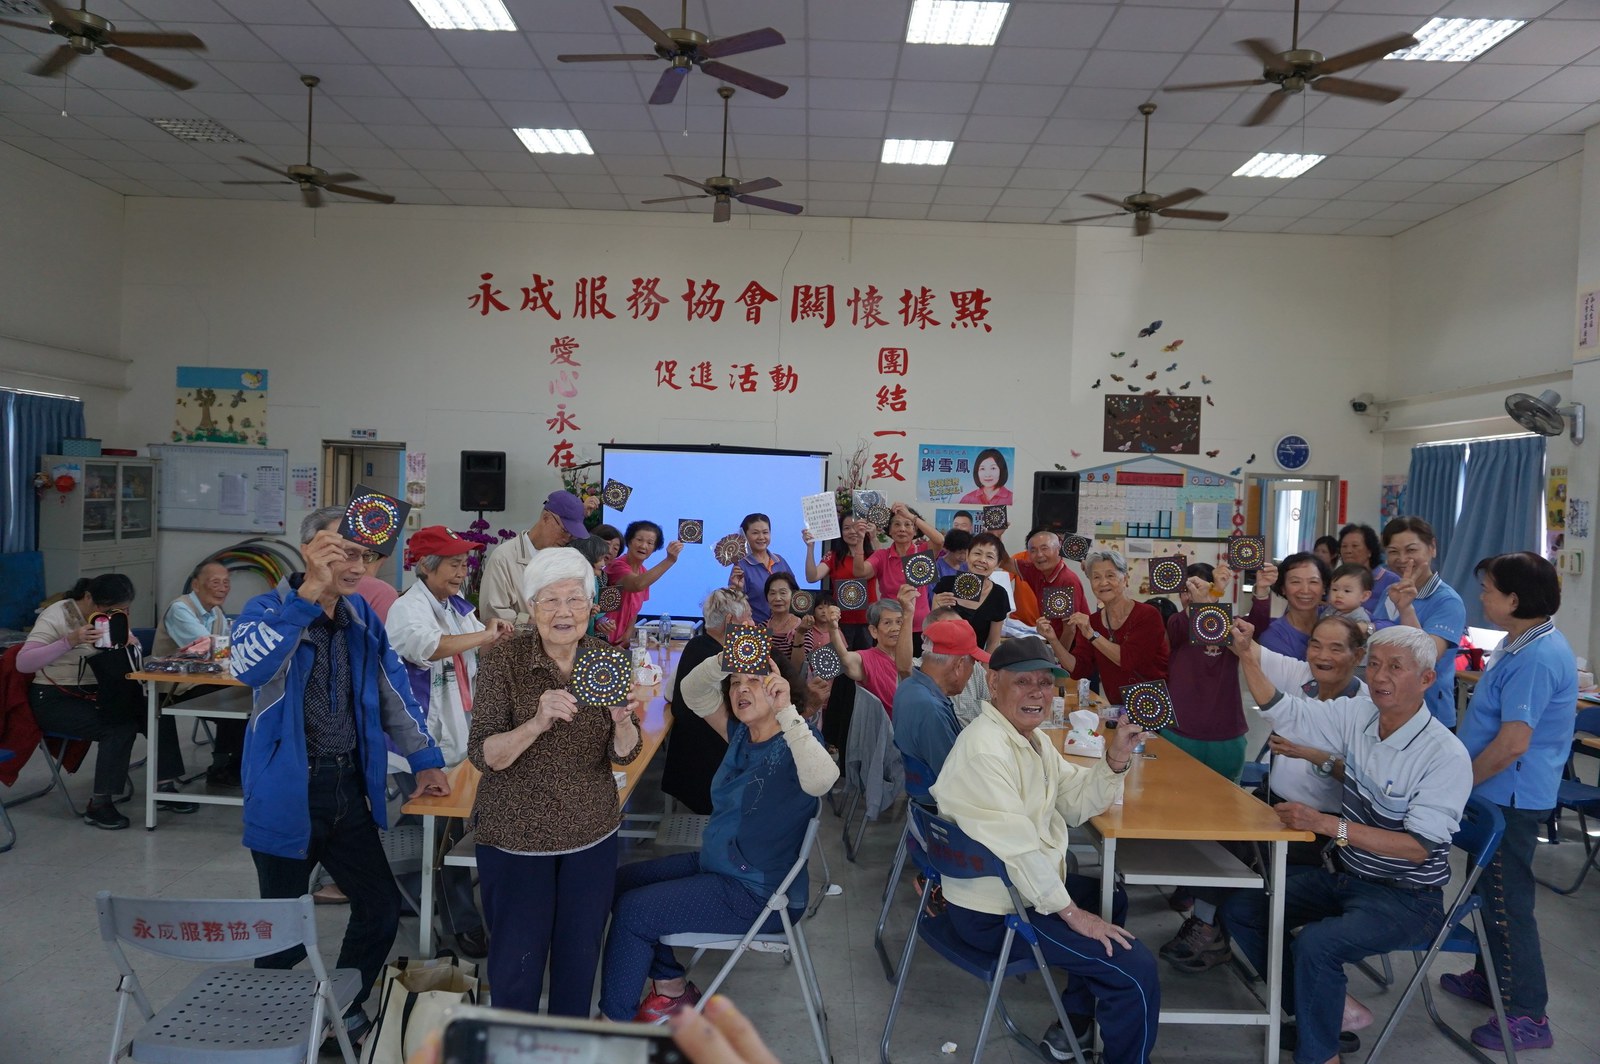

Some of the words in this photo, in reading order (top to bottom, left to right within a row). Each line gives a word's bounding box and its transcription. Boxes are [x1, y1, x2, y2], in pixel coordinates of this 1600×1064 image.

[467, 272, 993, 333] 永成服務協會關懷據點
[655, 359, 799, 394] 促進活動
[546, 336, 581, 468] 愛心永在
[871, 347, 909, 481] 團結一致
[922, 457, 970, 473] 謝雪鳳
[133, 918, 273, 943] 永成服務協會
